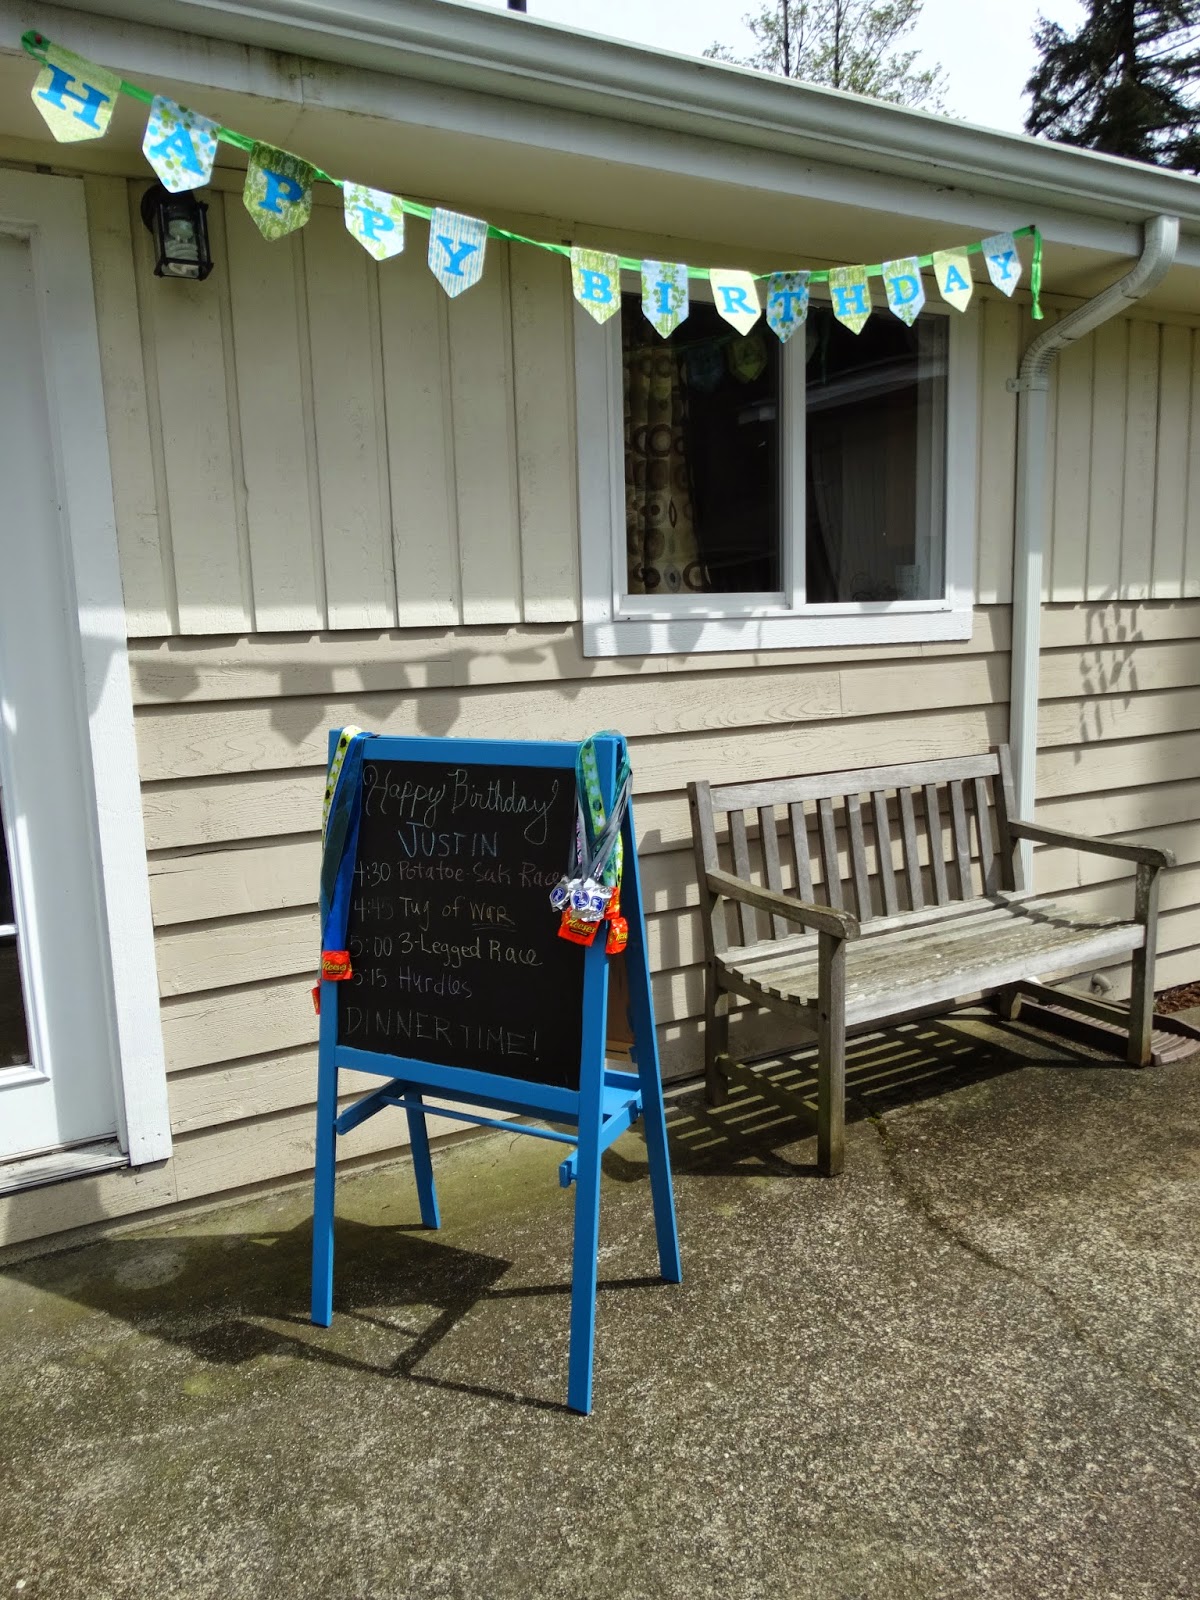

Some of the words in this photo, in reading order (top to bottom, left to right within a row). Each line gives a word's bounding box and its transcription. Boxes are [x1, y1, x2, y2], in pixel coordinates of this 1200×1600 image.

[581, 250, 1014, 323] BIRTHDAY
[363, 764, 446, 828] Happy
[447, 768, 559, 845] Birthday
[397, 821, 498, 858] JUSTIN
[354, 861, 391, 888] 4:30
[399, 896, 430, 932] Tug
[442, 895, 466, 917] of
[488, 939, 544, 967] Race
[398, 965, 473, 999] Hurdles
[344, 1006, 453, 1047] DINNER
[459, 1021, 541, 1062] TIME!
